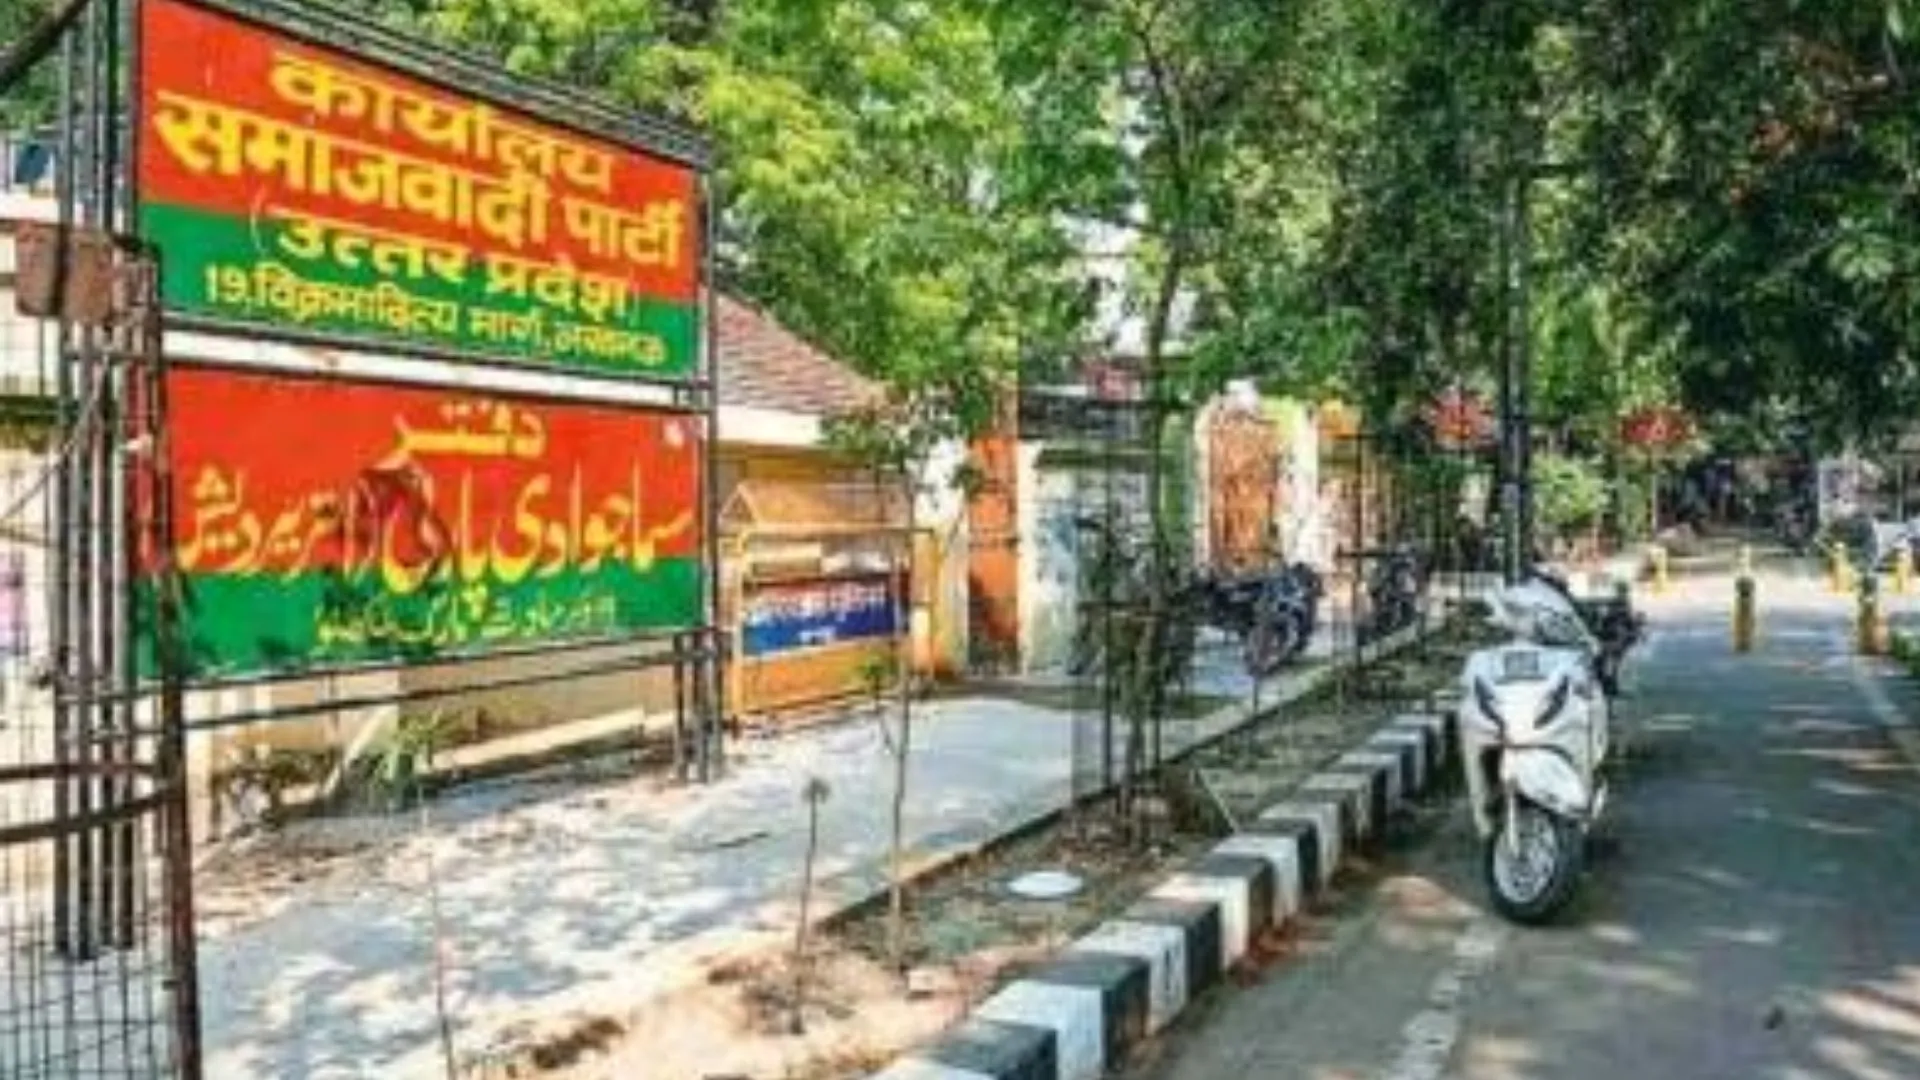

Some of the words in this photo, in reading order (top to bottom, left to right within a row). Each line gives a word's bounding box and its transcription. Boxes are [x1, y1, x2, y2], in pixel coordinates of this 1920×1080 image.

[155, 90, 550, 248] समाजवादी
[561, 196, 683, 269] पार्टी
[267, 50, 614, 193] कार्यालय
[375, 400, 547, 470] دفتر
